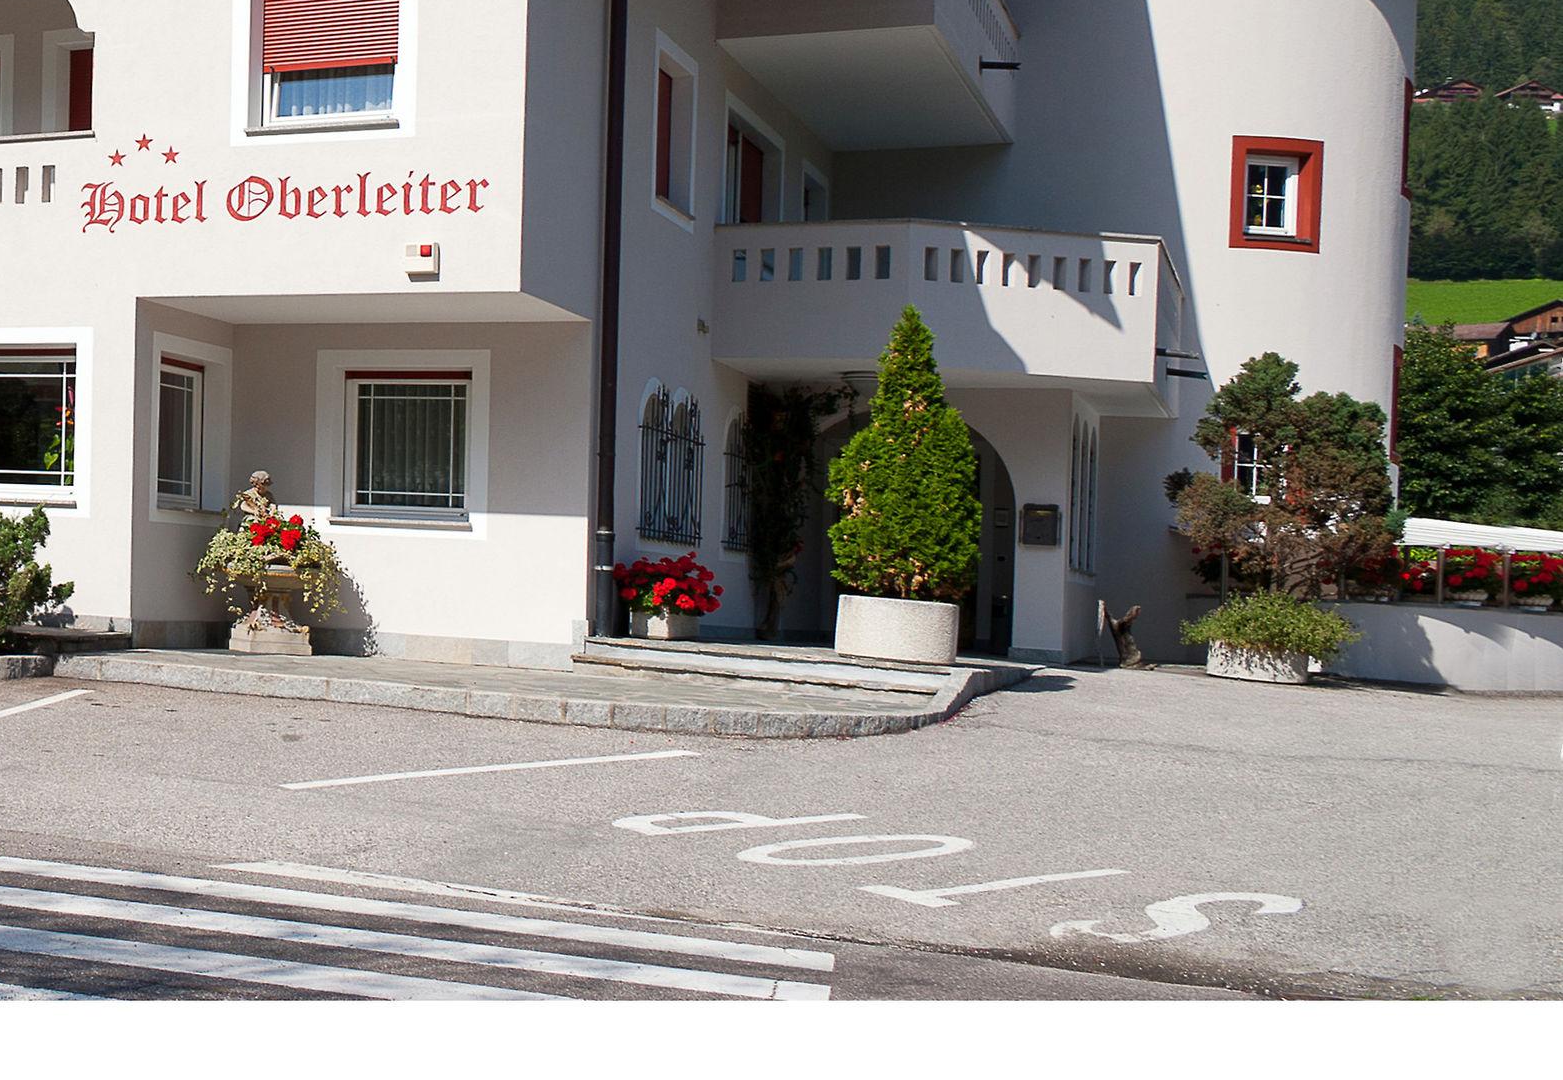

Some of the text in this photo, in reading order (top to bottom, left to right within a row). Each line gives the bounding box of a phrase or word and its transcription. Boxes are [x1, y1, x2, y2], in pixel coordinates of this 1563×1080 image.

[80, 171, 489, 234] Hotel Oberleiter
[612, 810, 1304, 943] STOP
